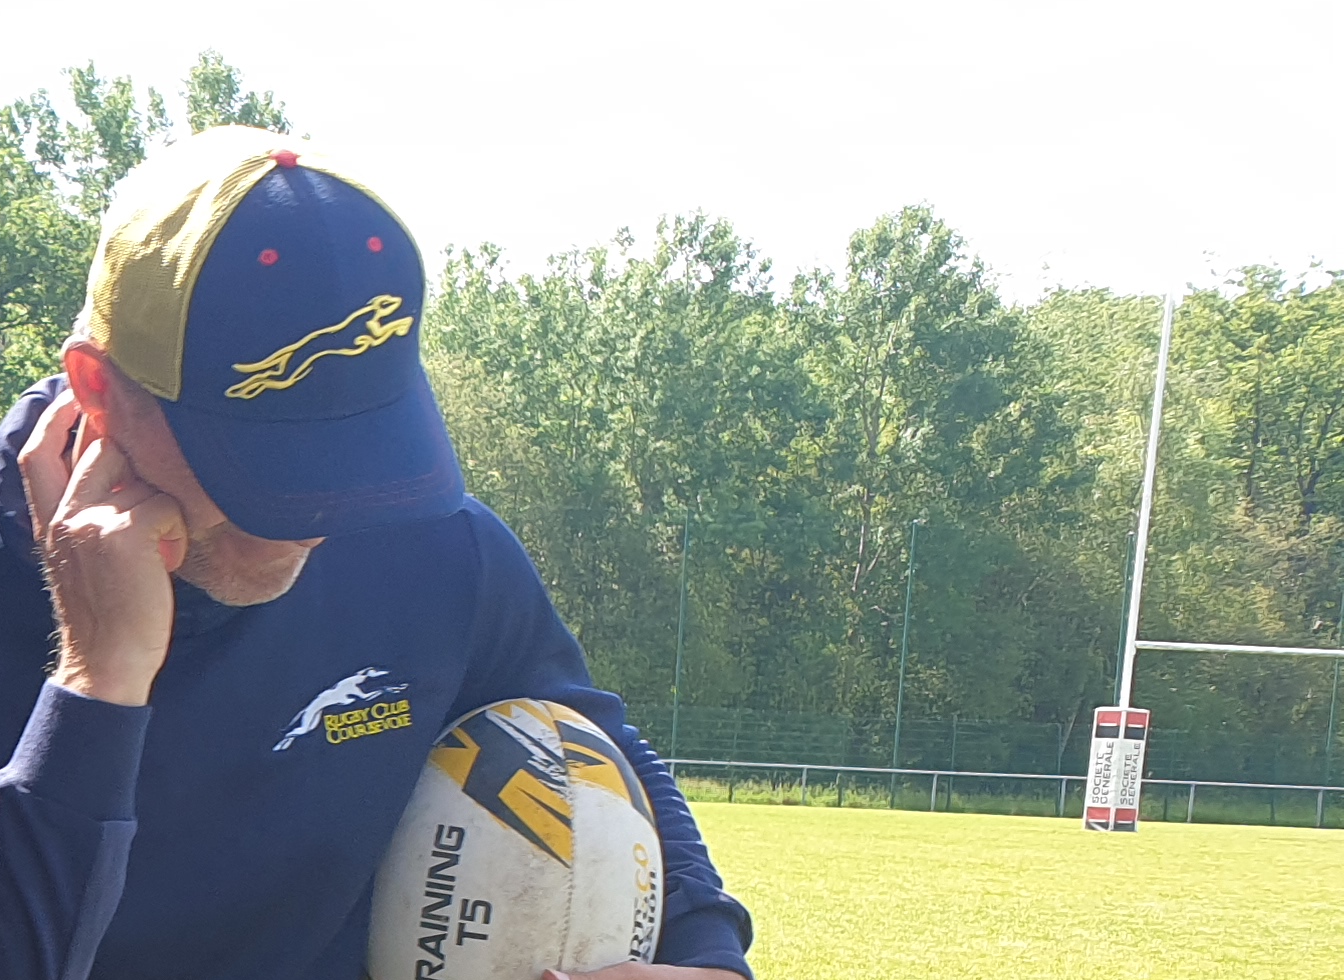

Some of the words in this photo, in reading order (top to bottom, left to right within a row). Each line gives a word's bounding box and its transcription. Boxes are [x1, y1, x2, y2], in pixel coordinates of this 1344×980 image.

[1120, 754, 1133, 805] SOCIETE
[1128, 742, 1141, 806] GENERALE
[456, 898, 493, 946] T5
